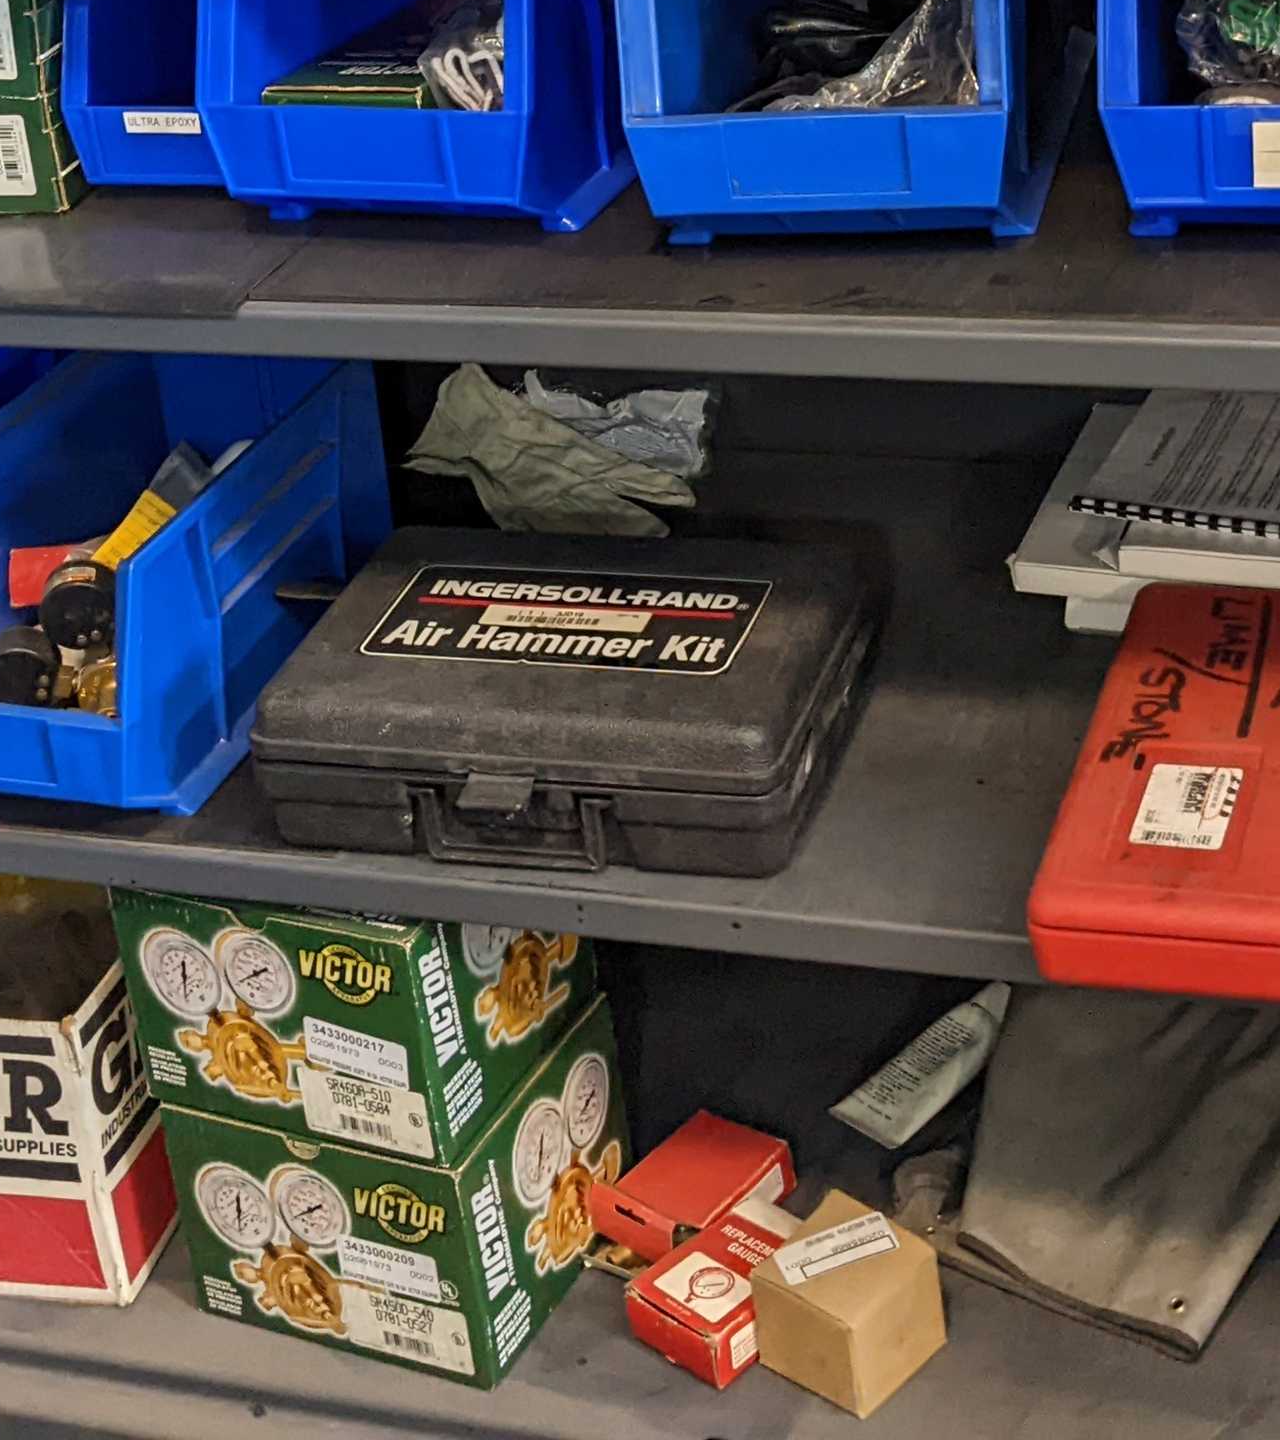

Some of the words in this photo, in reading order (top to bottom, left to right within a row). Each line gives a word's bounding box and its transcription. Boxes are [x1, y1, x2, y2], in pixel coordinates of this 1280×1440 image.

[166, 117, 197, 127] EPOXY
[430, 579, 740, 611] INGERSOLL-RAND
[381, 619, 454, 647] Air
[456, 627, 652, 660] Hammer
[659, 635, 725, 664] Kit
[298, 949, 392, 994] VICTOR
[418, 950, 460, 1067] VICTOR
[312, 1023, 386, 1053] 3433000217
[354, 1187, 445, 1233] VICTOR
[344, 1240, 415, 1266] 3433000209
[473, 1183, 510, 1300] VICTOR
[728, 1243, 764, 1266] GAUGE
